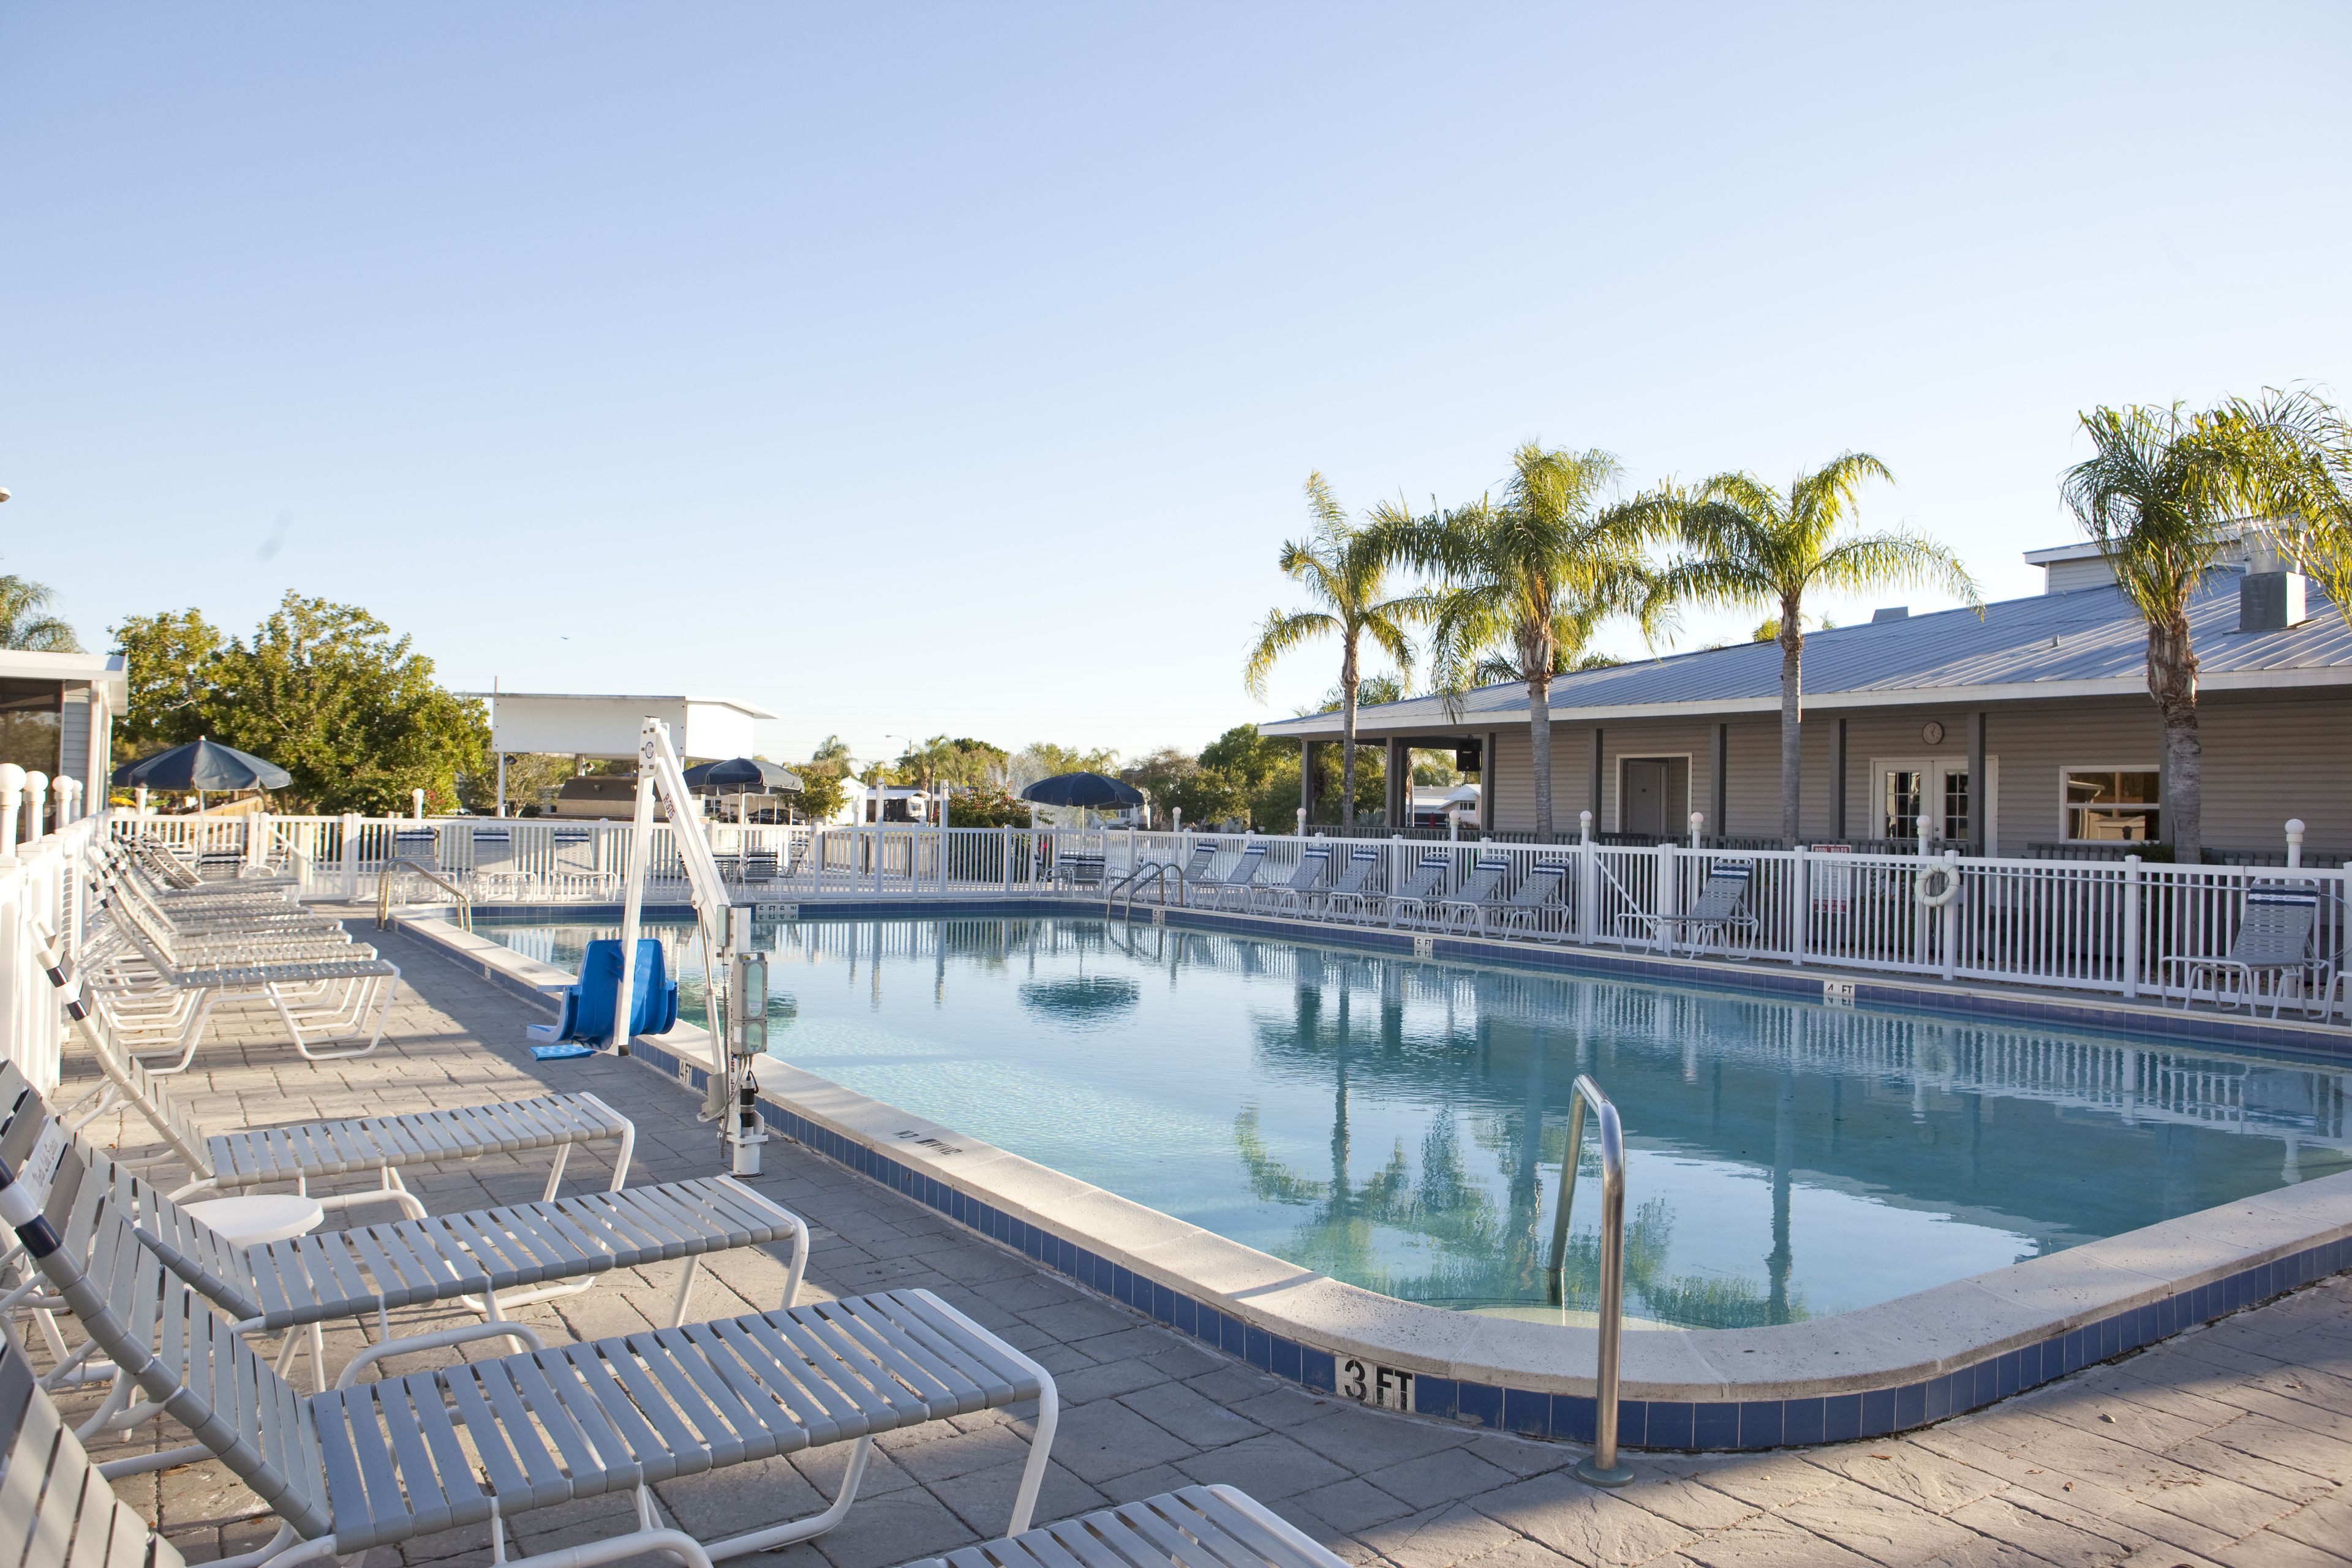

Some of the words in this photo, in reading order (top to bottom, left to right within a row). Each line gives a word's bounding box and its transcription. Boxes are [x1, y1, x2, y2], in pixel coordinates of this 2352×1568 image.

[1842, 985, 1853, 994] FT
[685, 1063, 692, 1085] FT
[1344, 1360, 1367, 1401] 3
[1376, 1366, 1413, 1411] FT
